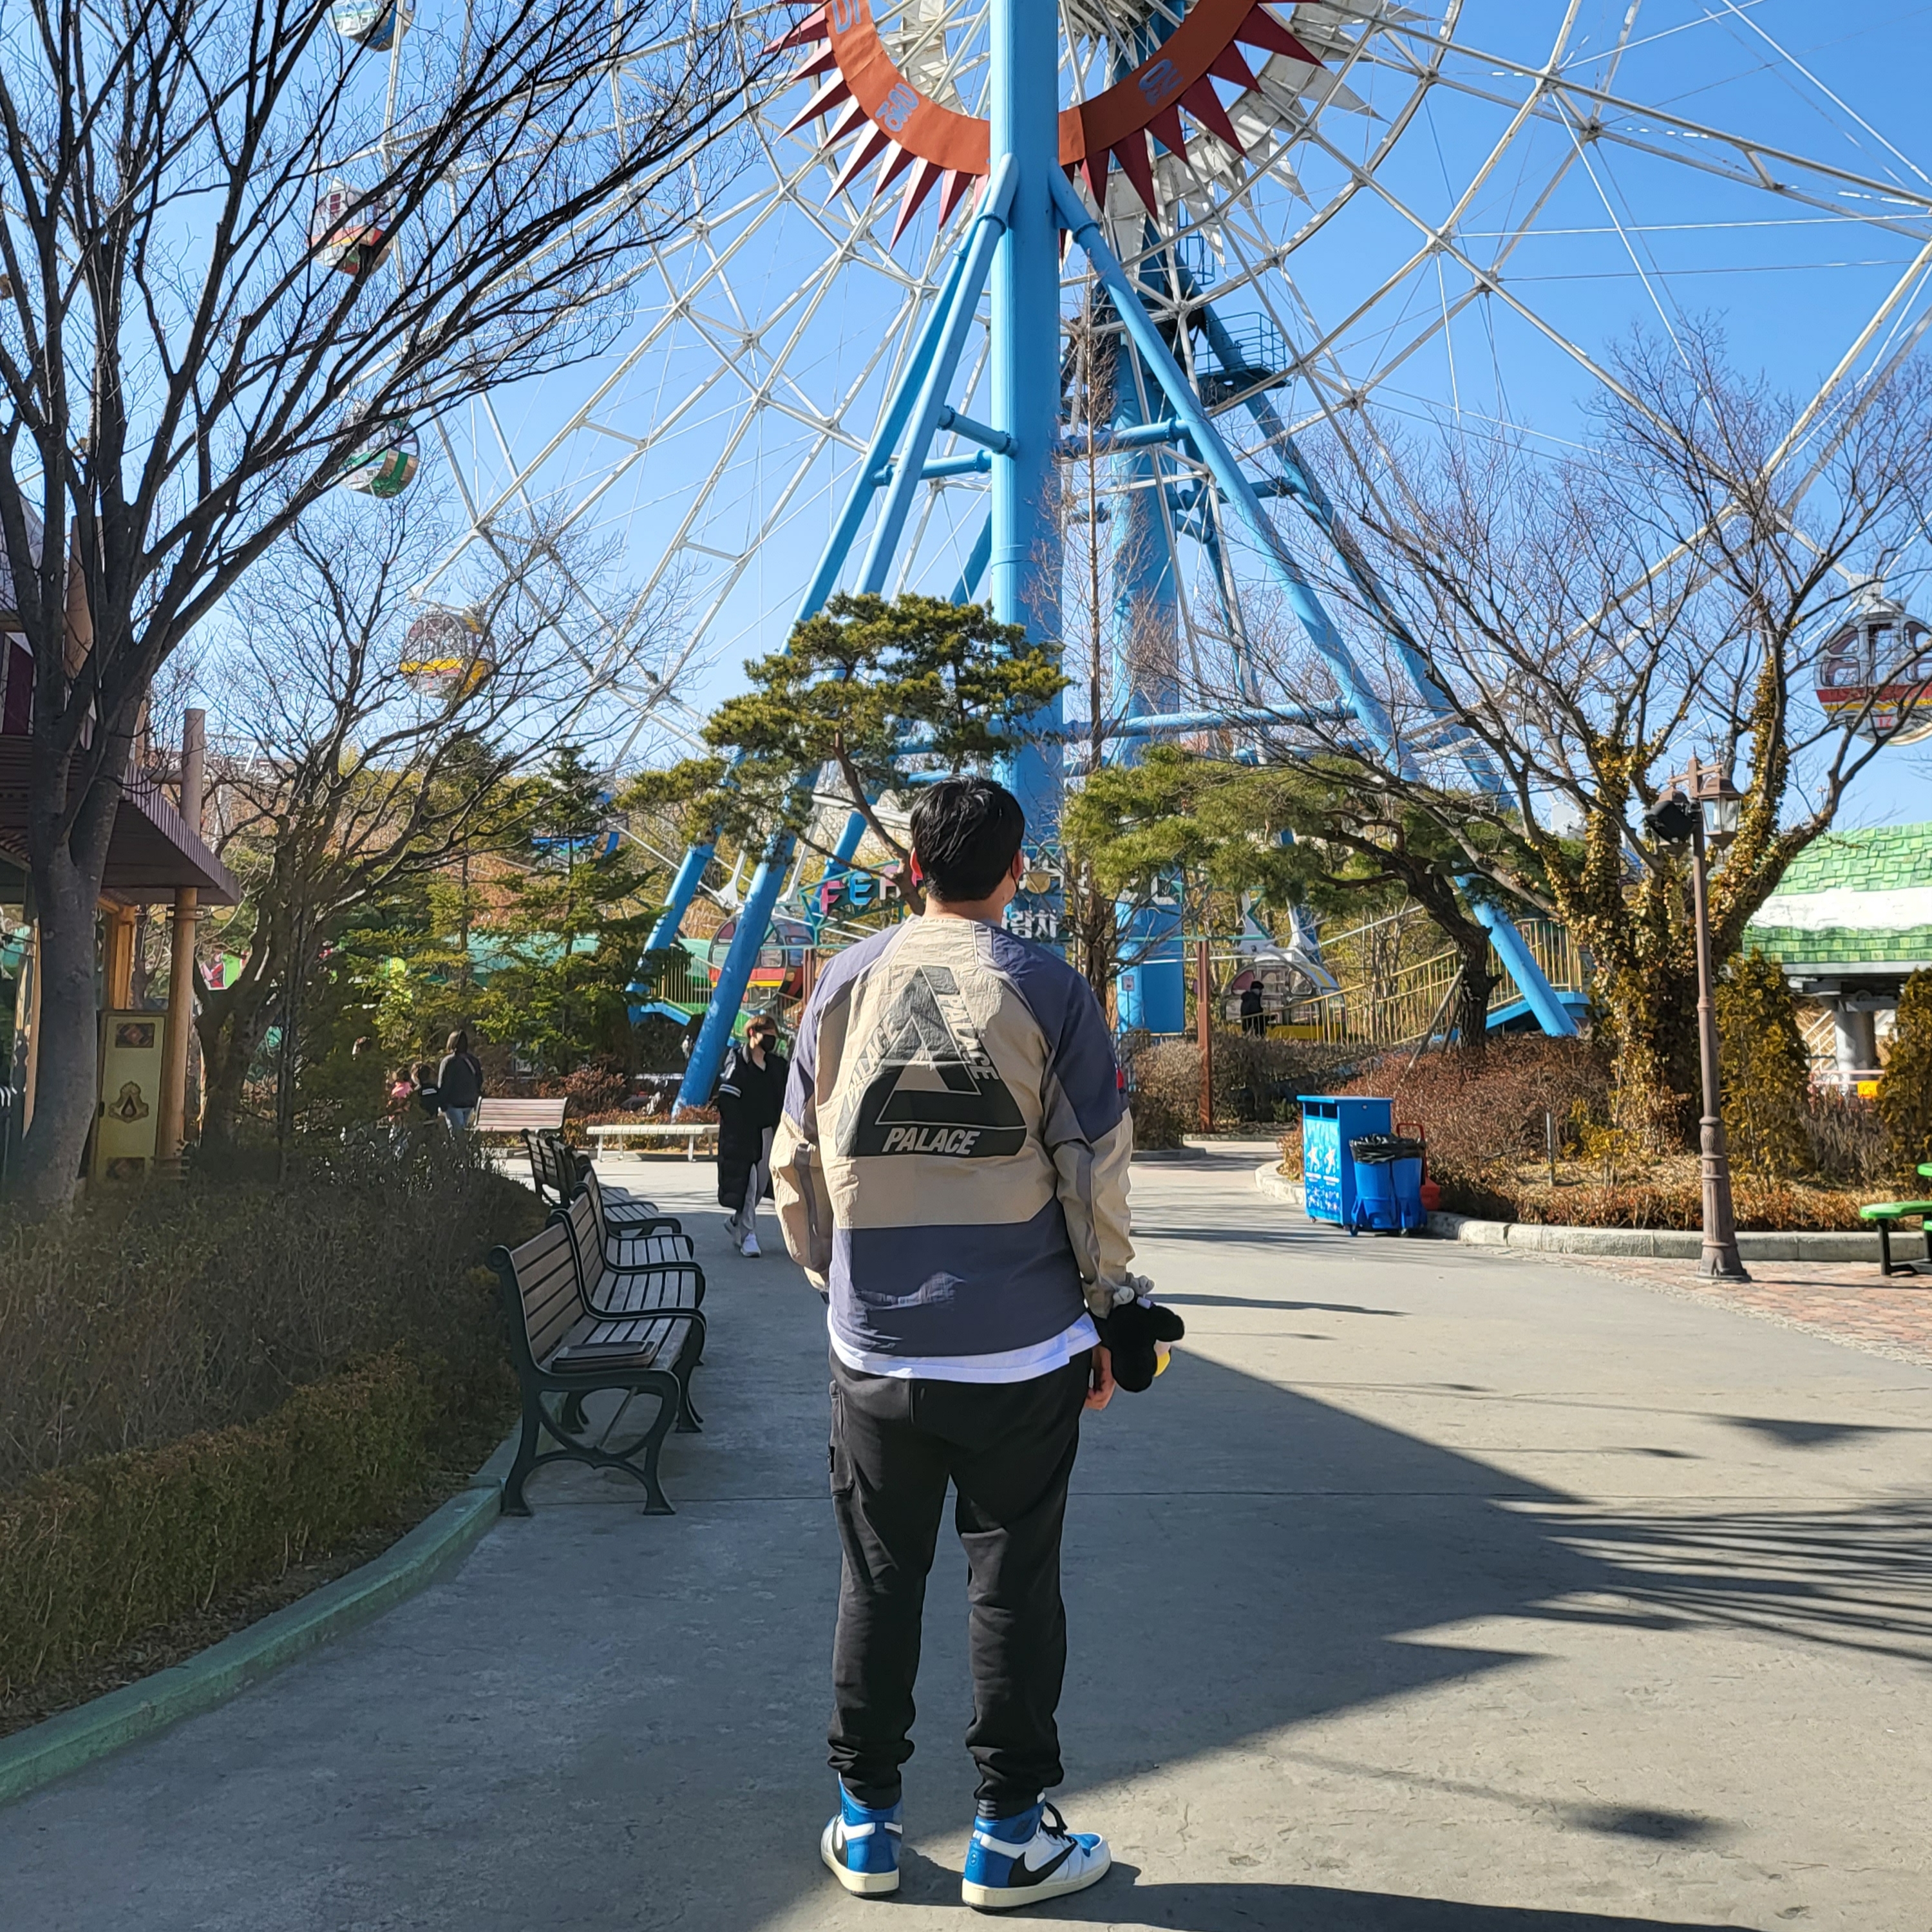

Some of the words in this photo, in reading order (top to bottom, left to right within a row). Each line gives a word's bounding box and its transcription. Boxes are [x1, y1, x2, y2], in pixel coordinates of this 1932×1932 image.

[846, 1013, 898, 1114] PALACE
[937, 994, 999, 1081] PALACE
[881, 1127, 981, 1155] PALACE
